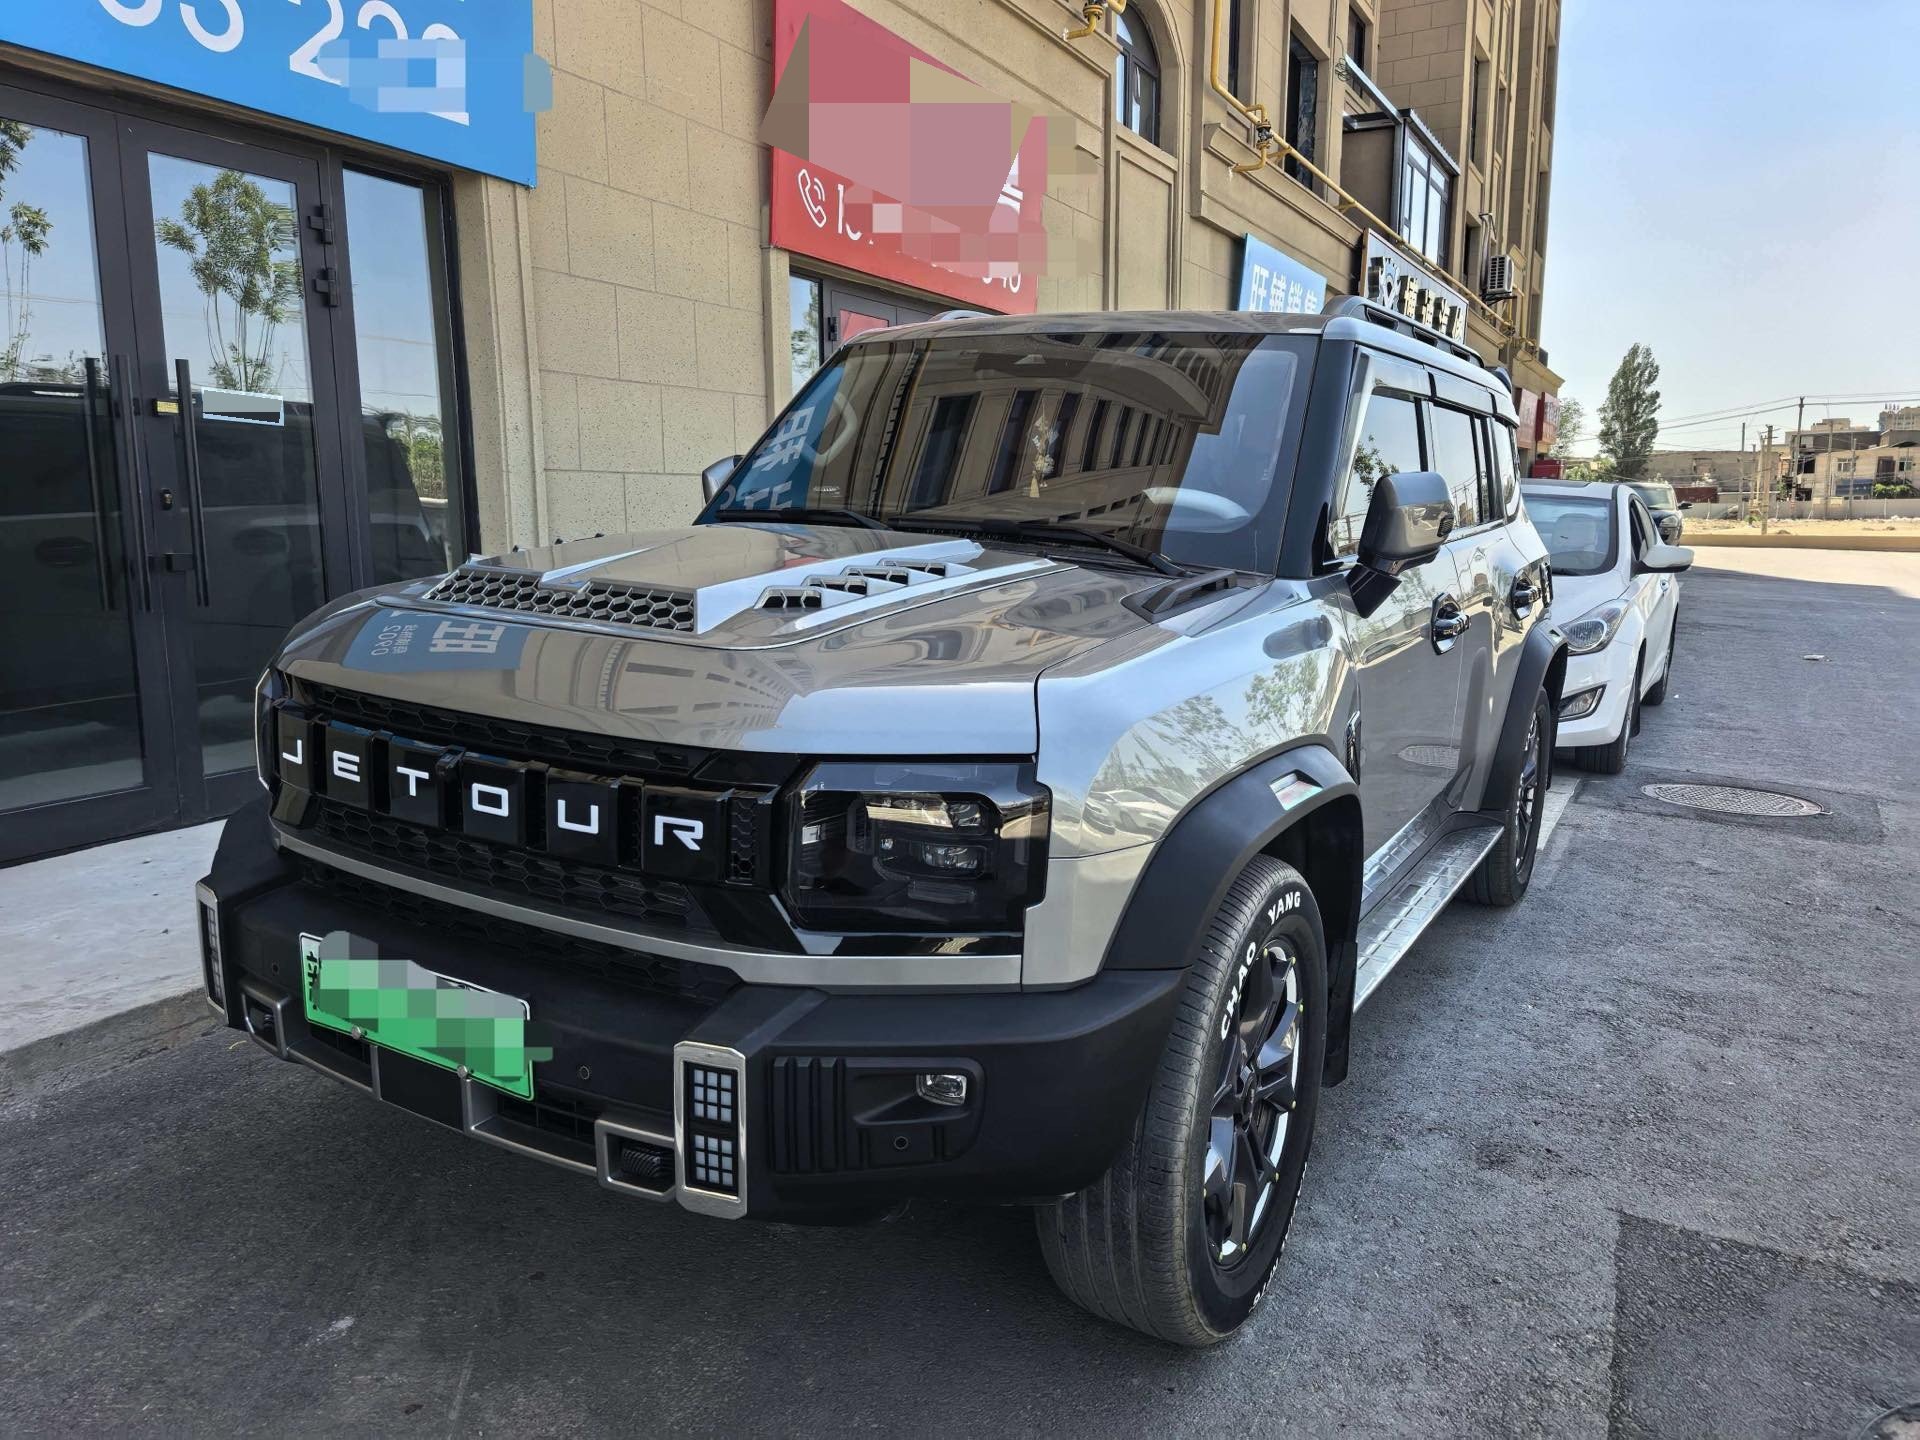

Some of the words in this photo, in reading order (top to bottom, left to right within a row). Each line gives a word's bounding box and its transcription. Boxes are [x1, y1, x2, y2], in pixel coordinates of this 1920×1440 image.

[282, 738, 704, 851] JETOUR
[1220, 941, 1257, 1041] CHAO
[1267, 891, 1301, 925] YANG
